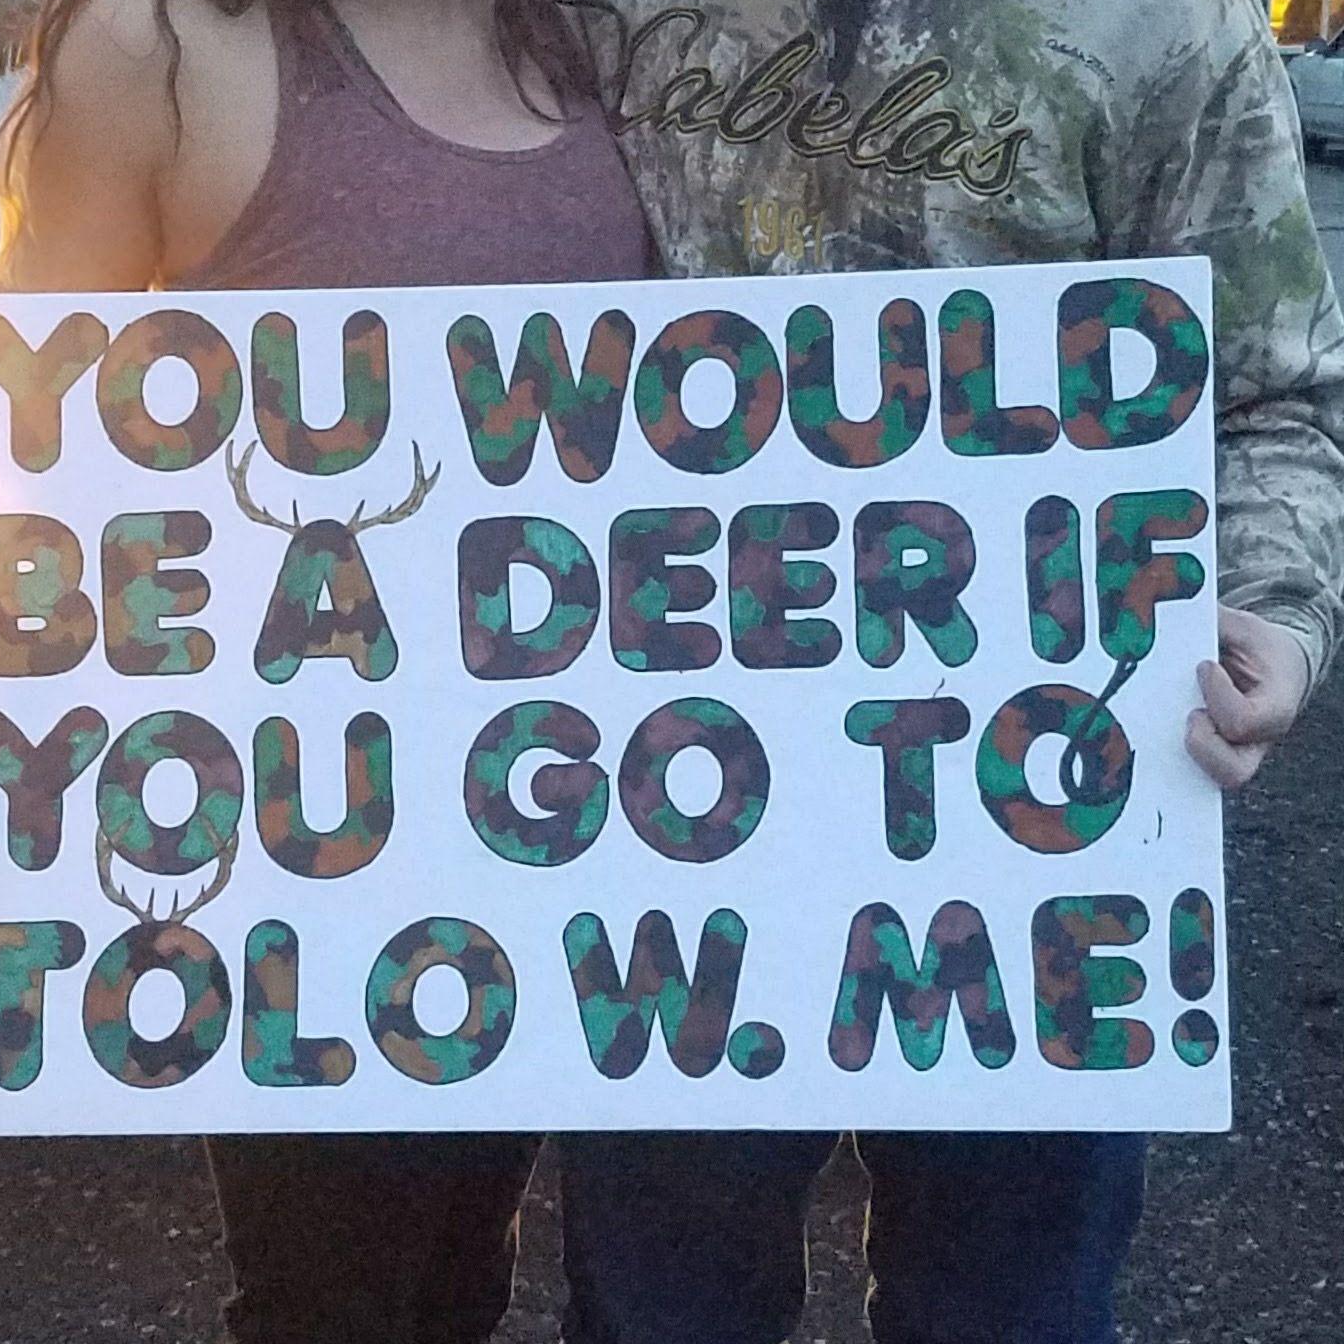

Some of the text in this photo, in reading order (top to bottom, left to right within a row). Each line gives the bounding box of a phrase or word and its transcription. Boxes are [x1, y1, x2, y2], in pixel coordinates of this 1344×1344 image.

[737, 195, 824, 266] 1961
[447, 278, 1209, 485] WOULD
[255, 519, 397, 684] A
[457, 500, 978, 681] DEER
[1025, 488, 1208, 663] IF
[463, 697, 770, 867] GO
[844, 683, 1133, 861] TO
[562, 907, 786, 1080] W.
[828, 886, 1218, 1072] ME!
